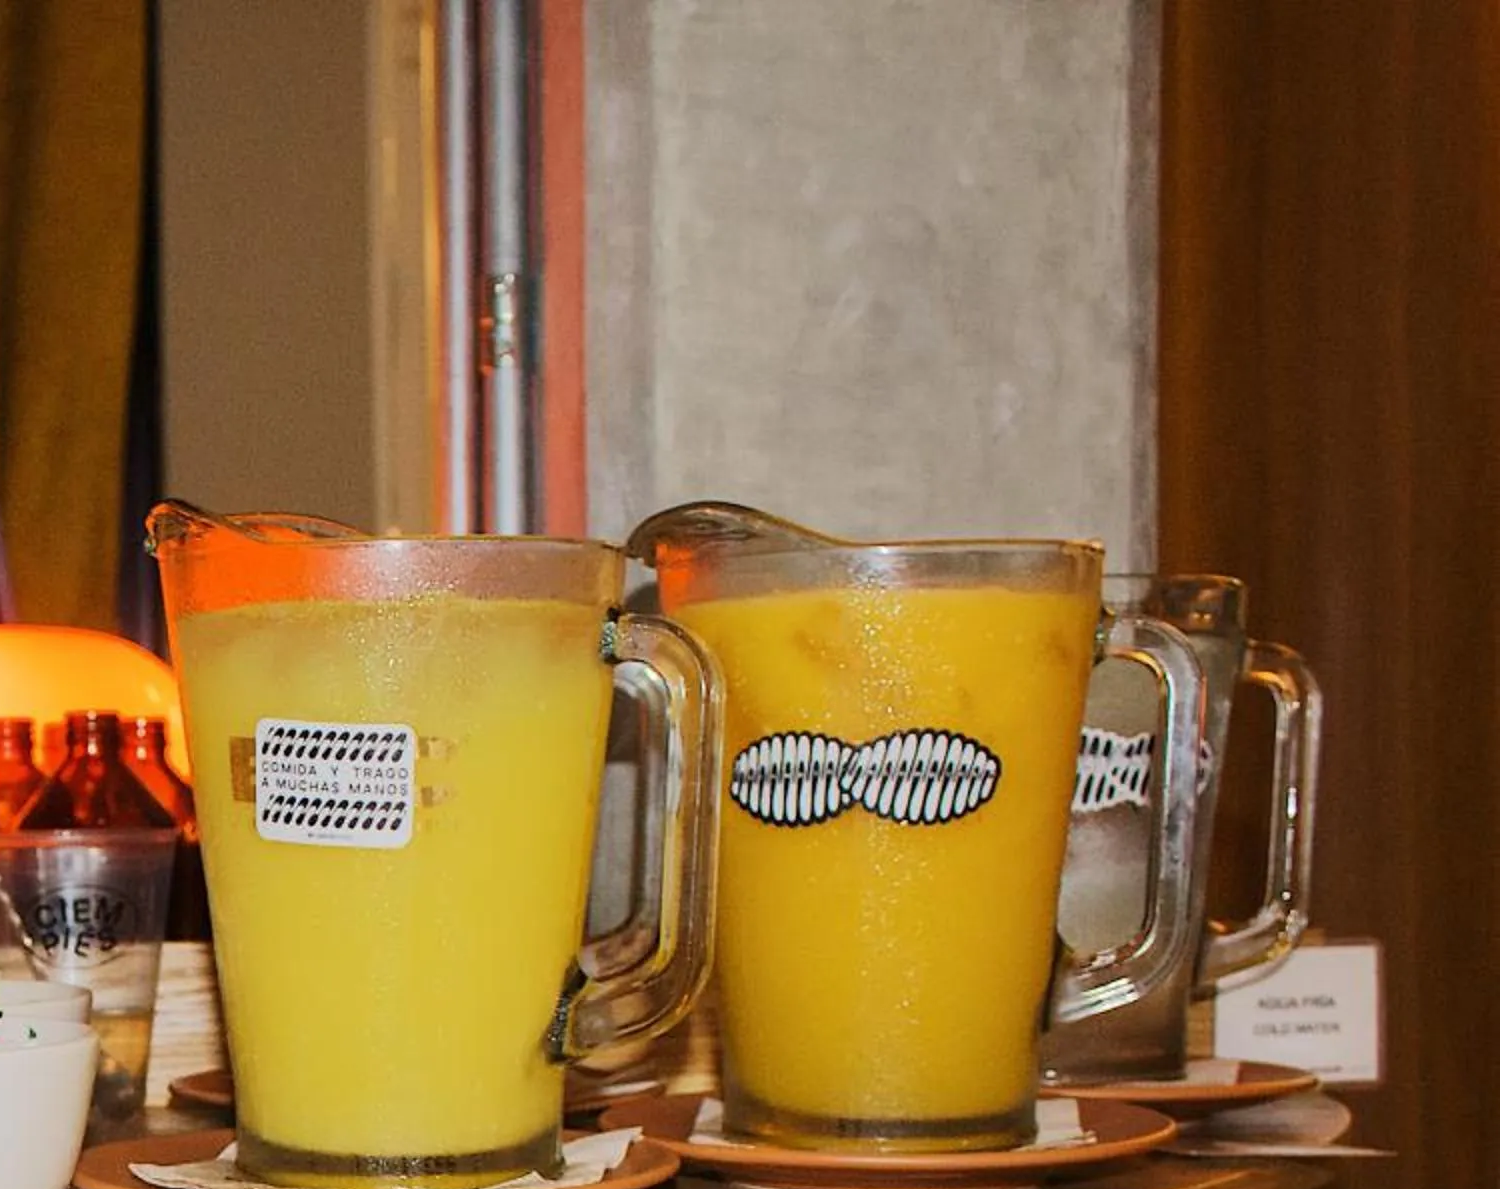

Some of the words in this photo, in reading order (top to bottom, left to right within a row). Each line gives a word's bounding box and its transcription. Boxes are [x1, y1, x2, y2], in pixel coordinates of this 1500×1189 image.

[261, 761, 317, 776] COMIDA
[330, 766, 339, 777] Y
[353, 767, 409, 780] TRAGO
[275, 778, 340, 794] MUCHAS
[349, 783, 409, 796] MANOS
[35, 896, 124, 928] CIEM
[1257, 996, 1299, 1010] AGUA
[1296, 1022, 1340, 1035] WATER
